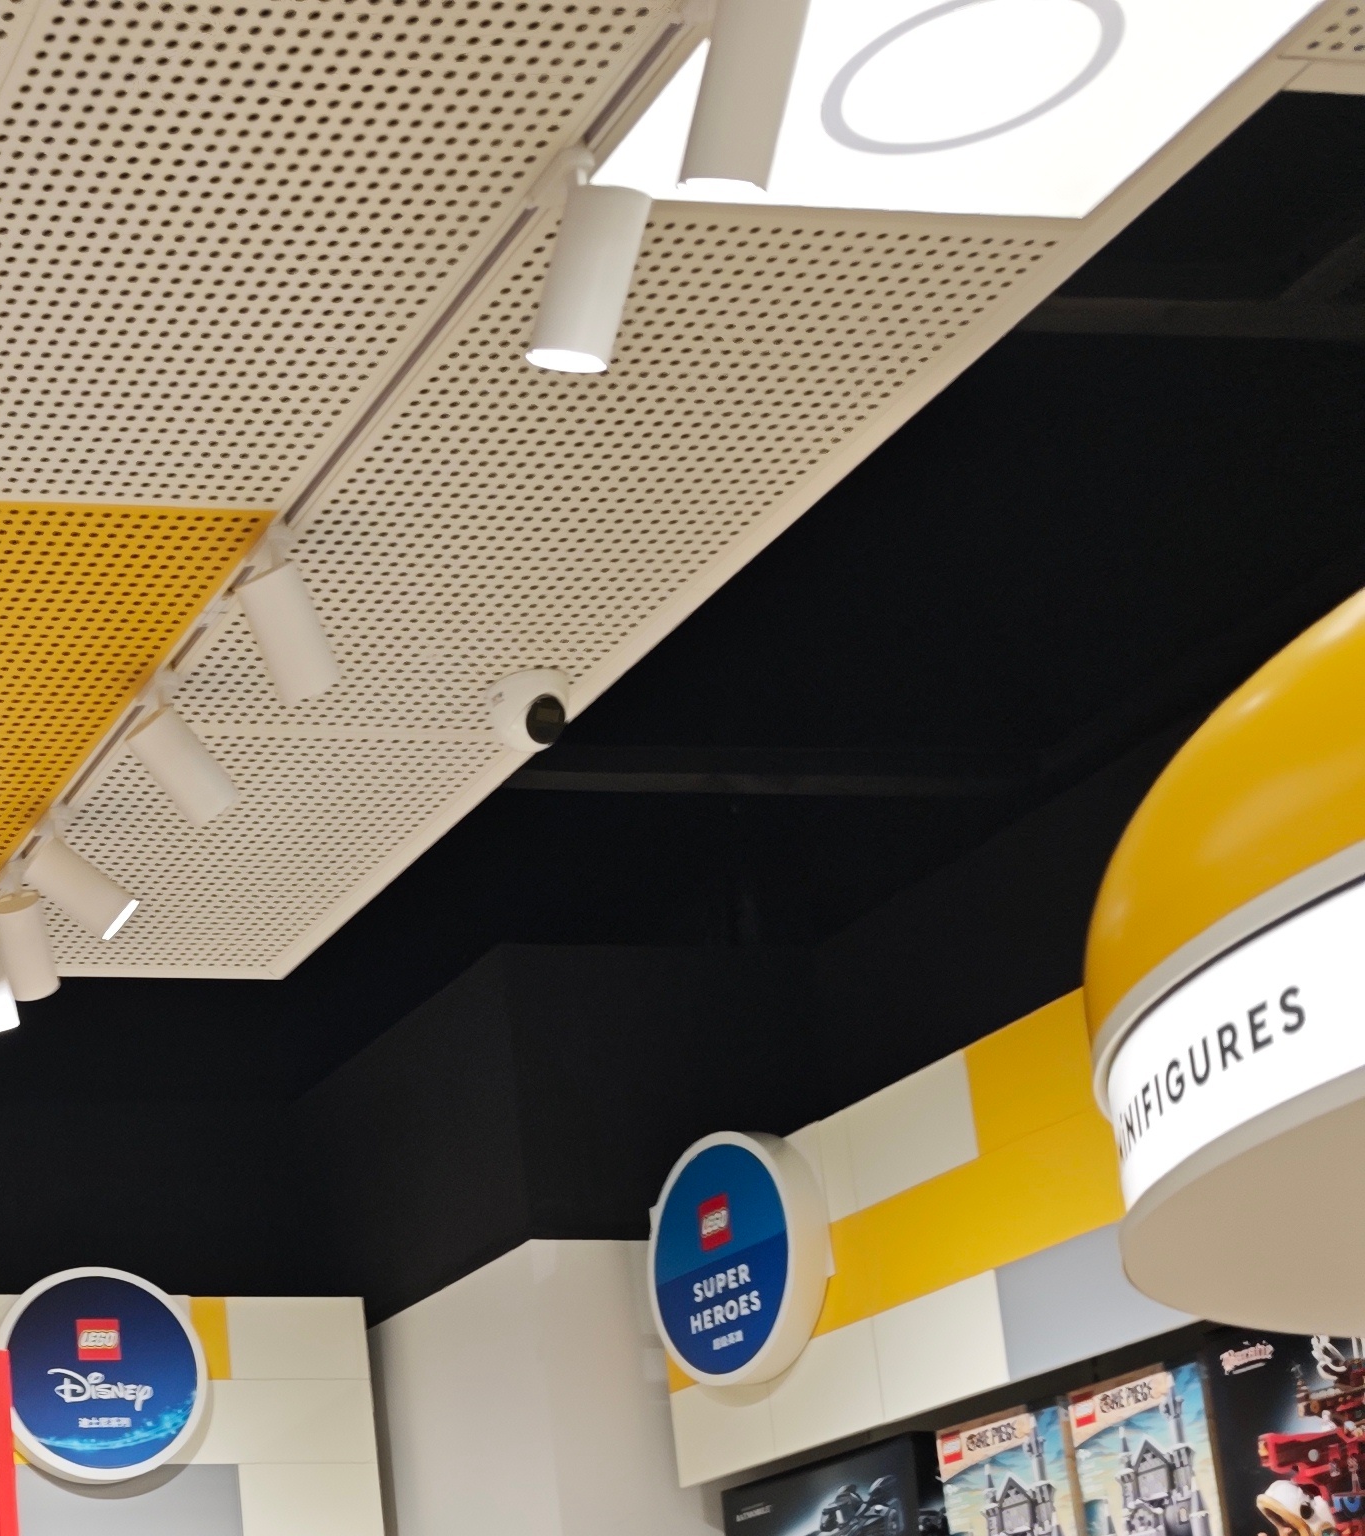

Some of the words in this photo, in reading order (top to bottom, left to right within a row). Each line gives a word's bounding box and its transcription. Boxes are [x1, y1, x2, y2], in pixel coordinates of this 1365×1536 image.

[1119, 985, 1307, 1161] INIFIGURES
[701, 1206, 730, 1238] LEGO
[693, 1263, 751, 1303] SUPER
[689, 1290, 762, 1335] HEROES
[78, 1329, 120, 1349] LEGO
